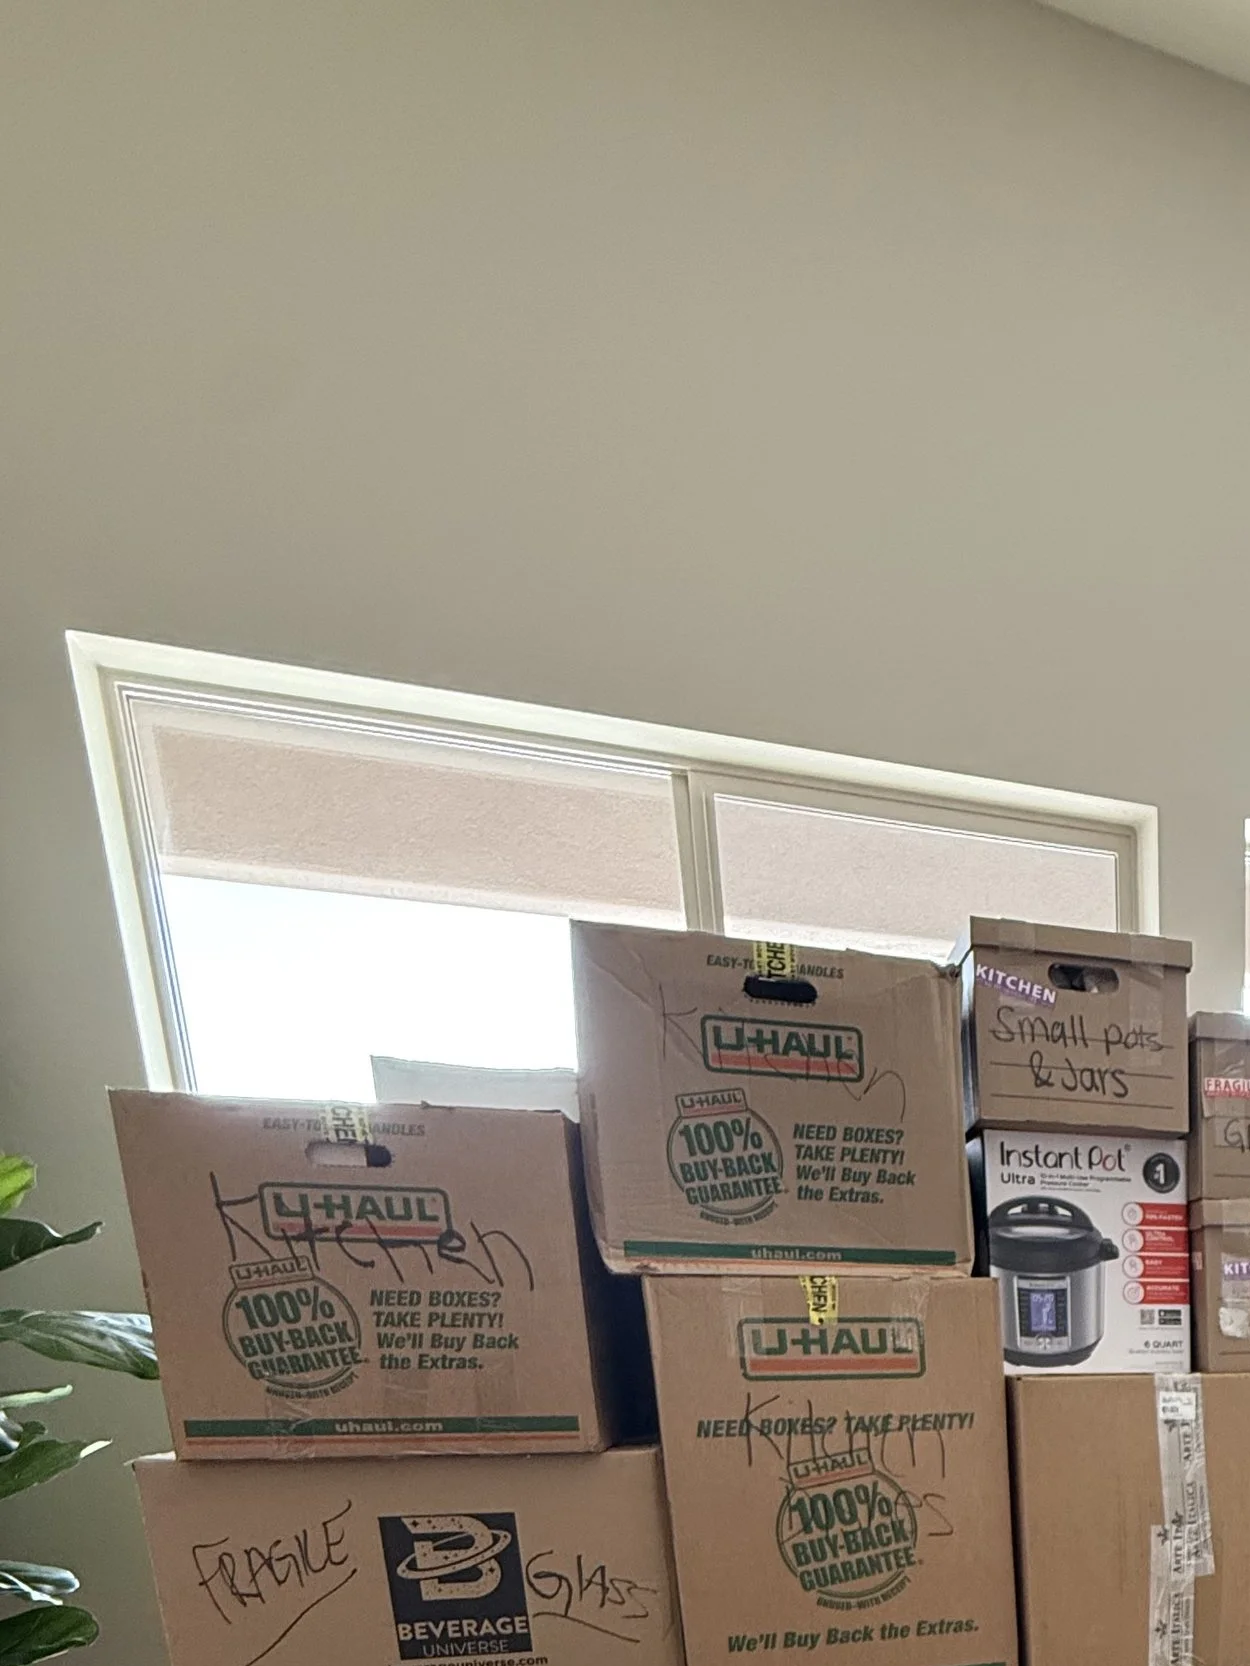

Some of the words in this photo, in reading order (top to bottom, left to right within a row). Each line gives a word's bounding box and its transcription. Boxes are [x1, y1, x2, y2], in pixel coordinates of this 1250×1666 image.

[976, 964, 1056, 1003] KITCHEN
[712, 1025, 856, 1059] U-HAUL
[992, 1006, 1088, 1048] Small
[1103, 1024, 1164, 1055] pots
[1029, 1050, 1054, 1088] &
[1061, 1058, 1129, 1098] Jars
[681, 1093, 742, 1109] U-HAUL
[679, 1117, 763, 1157] 100%
[793, 1124, 836, 1140] NEED
[843, 1127, 904, 1145] BOXES?
[679, 1152, 776, 1183] BUY-BACK
[795, 1145, 834, 1161] TAKE
[840, 1146, 905, 1165] PLENTY!
[1000, 1142, 1082, 1170] Instant
[1088, 1145, 1126, 1172] Pot
[796, 1165, 835, 1181] We'll
[841, 1167, 871, 1185] Buy
[876, 1169, 915, 1186] Back
[1000, 1172, 1036, 1185] Ultra
[273, 1192, 439, 1221] U-HAUL
[797, 1185, 823, 1201] the
[829, 1187, 884, 1204] Extras.
[210, 1171, 534, 1291] Kitchen
[751, 1248, 841, 1261] uhaul.com
[235, 1260, 307, 1280] U-HAUL
[235, 1285, 336, 1330] 100%
[370, 1289, 422, 1307] NEED
[429, 1290, 501, 1308] BOXES?
[373, 1311, 421, 1328] TAKE
[428, 1312, 504, 1329] PLENTY!
[239, 1320, 353, 1358] BUY-BACK
[377, 1333, 423, 1349] We'll
[430, 1333, 467, 1352] Buy
[473, 1333, 519, 1350] Back
[751, 1326, 914, 1355] U-HAUL
[1152, 1340, 1184, 1348] QUART
[380, 1354, 412, 1370] the
[418, 1354, 484, 1370] Extras.
[335, 1418, 443, 1433] uhaul.com
[697, 1419, 751, 1438] NEED
[760, 1416, 837, 1436] BOXES?
[845, 1412, 894, 1433] TAKE
[899, 1411, 974, 1432] PLENTY!
[791, 1480, 892, 1535] 100%
[792, 1519, 909, 1567] BUY-BACK
[193, 1500, 351, 1625] FRAGILE
[398, 1616, 529, 1641] BEVERAGE
[728, 1631, 777, 1653] We'll
[783, 1628, 820, 1650] Buy
[826, 1624, 873, 1643] Back
[879, 1621, 910, 1640] the
[916, 1617, 979, 1637] Extras.
[423, 1640, 510, 1658] UNIVERSE
